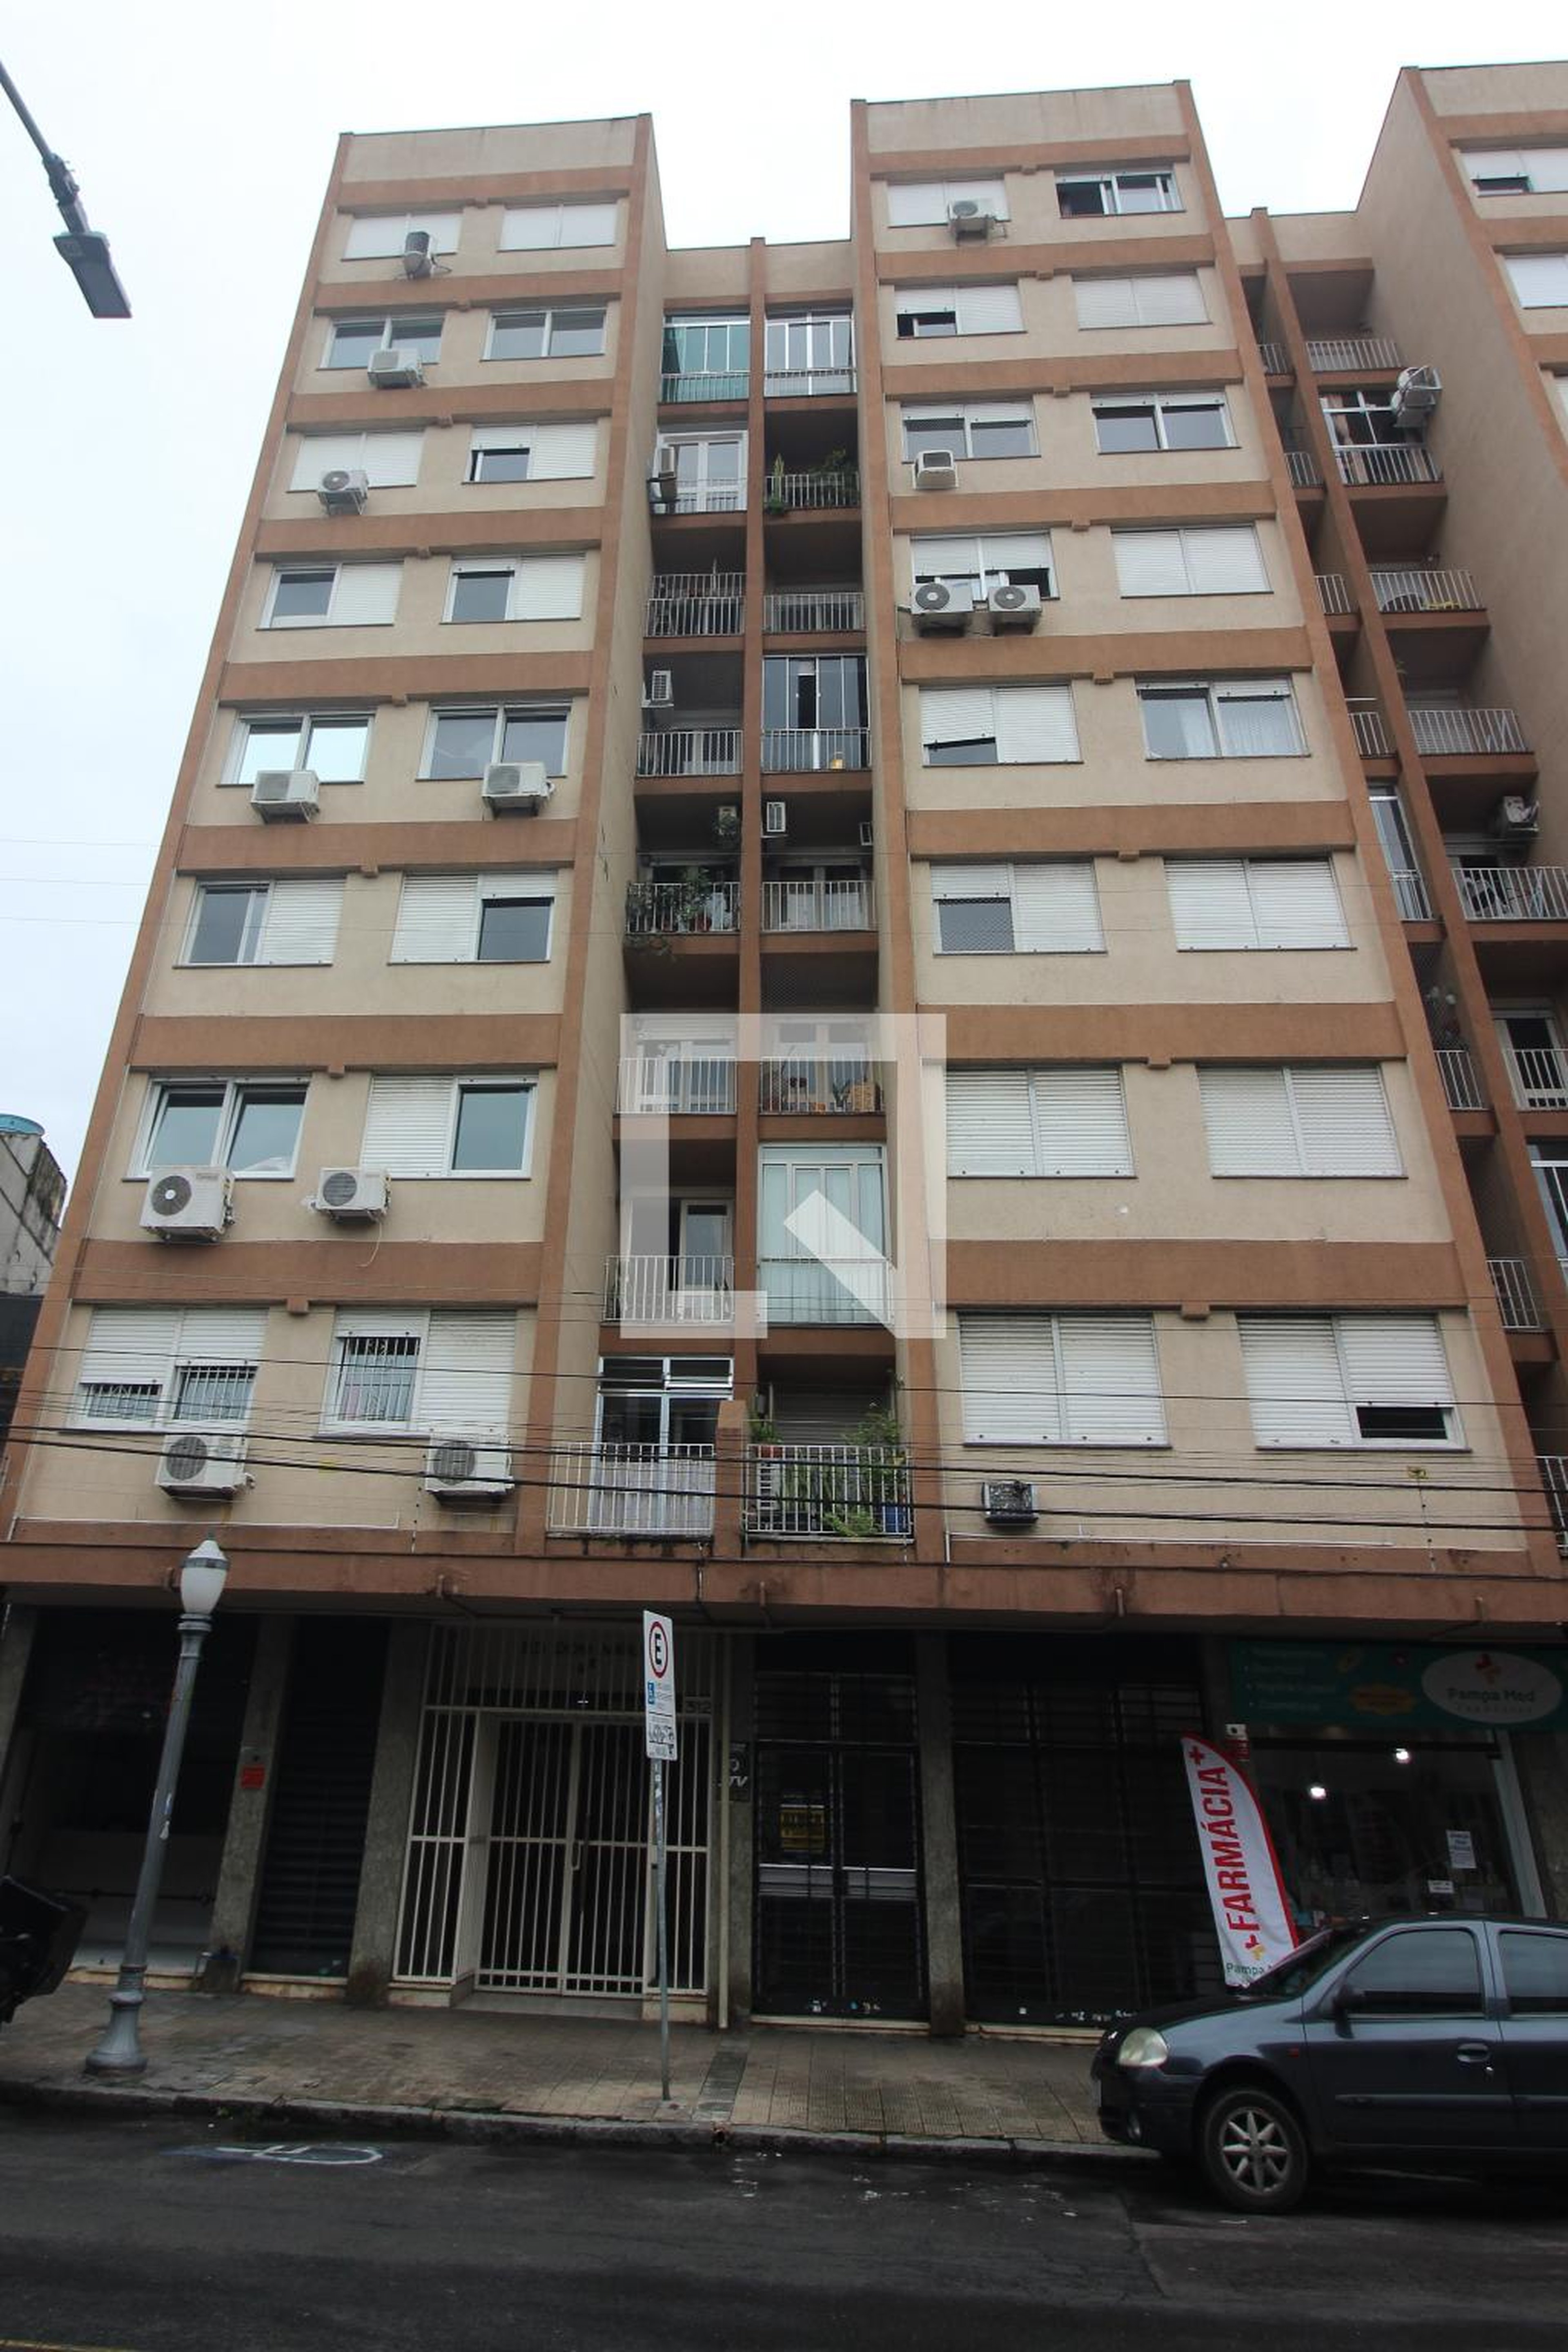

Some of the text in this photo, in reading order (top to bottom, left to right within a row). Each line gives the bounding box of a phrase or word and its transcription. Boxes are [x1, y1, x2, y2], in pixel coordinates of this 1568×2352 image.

[1448, 1688, 1535, 1703] Pampa Med
[1200, 1766, 1259, 1931] FARMÁCIA
